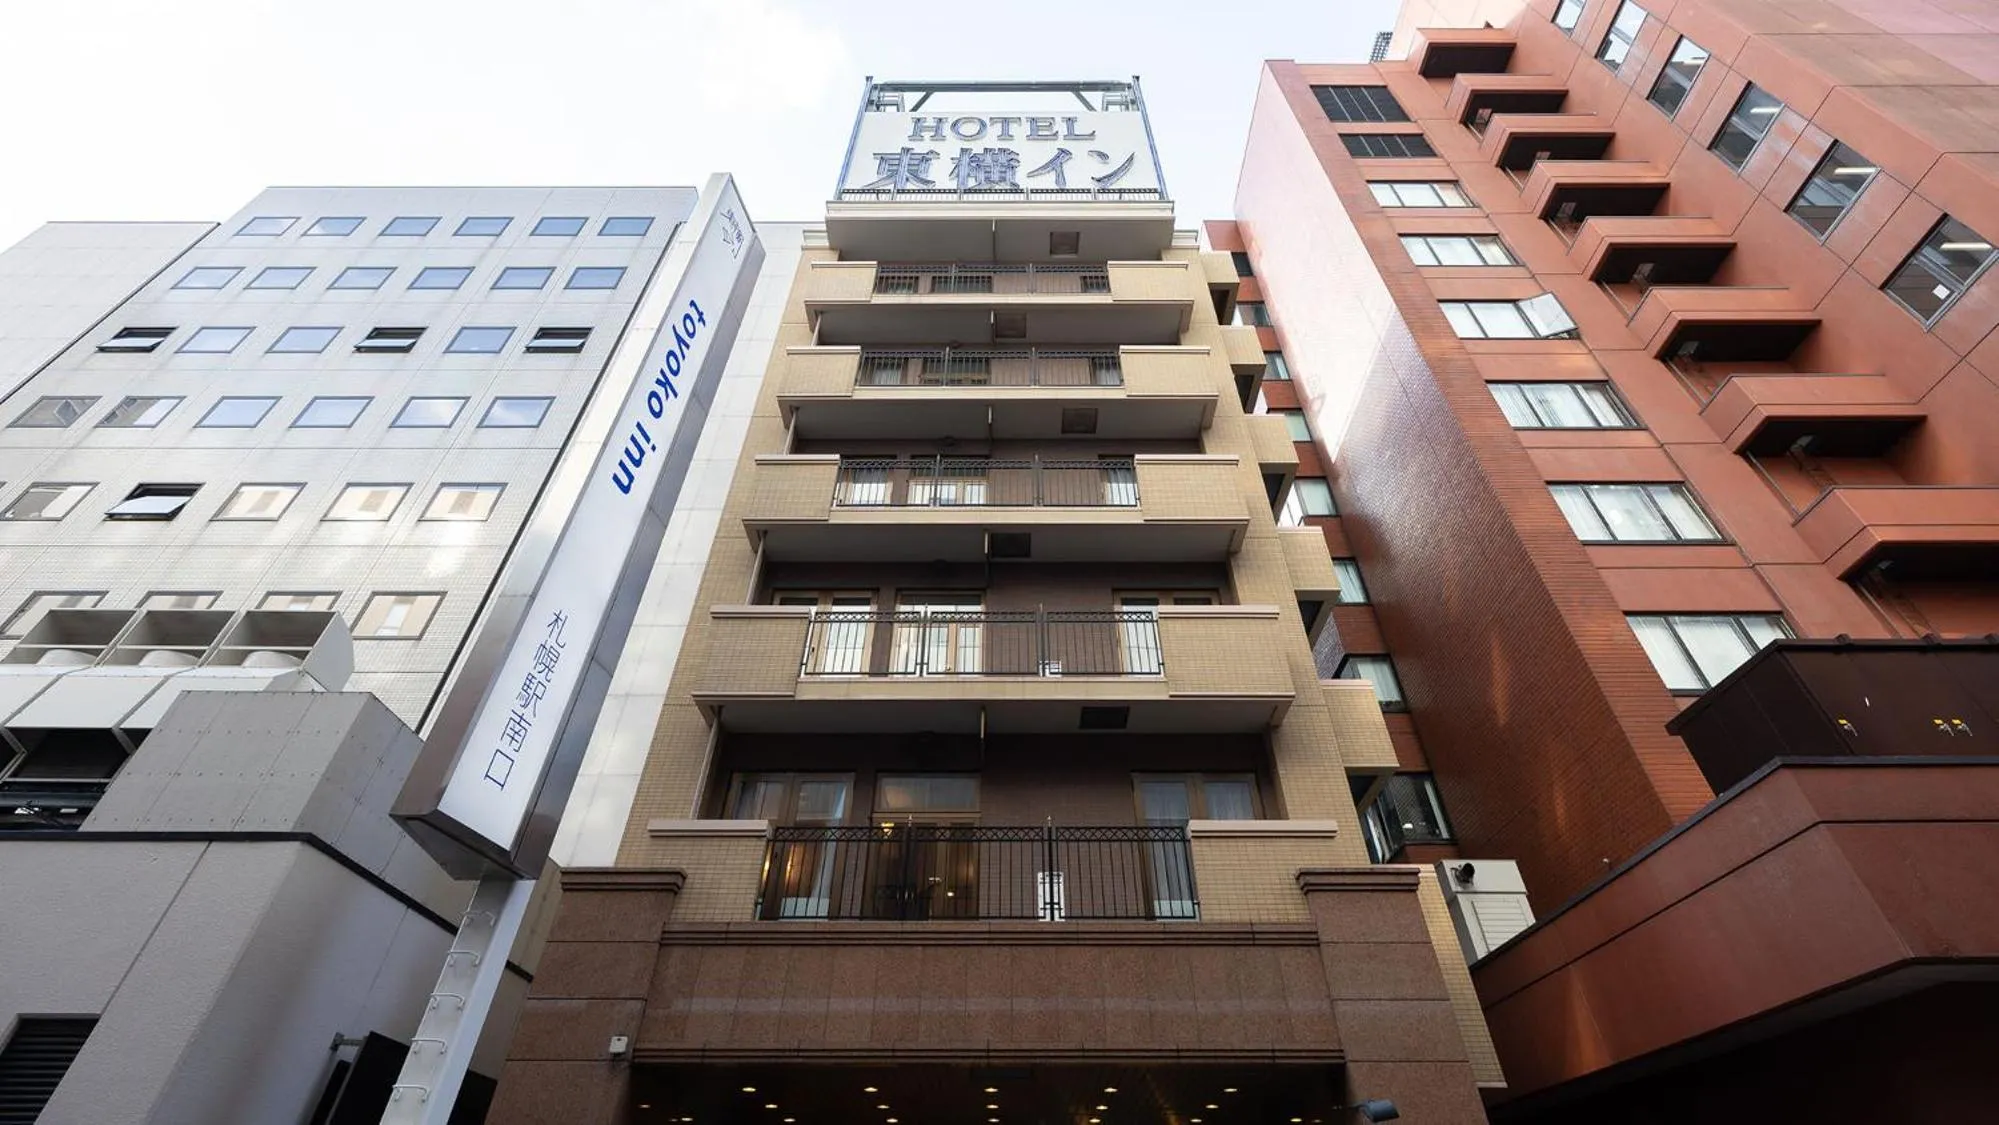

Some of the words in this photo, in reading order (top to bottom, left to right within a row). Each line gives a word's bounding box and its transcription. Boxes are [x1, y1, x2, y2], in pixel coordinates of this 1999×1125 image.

[907, 116, 1097, 142] HOTEL
[863, 147, 1136, 189] 東横イン
[647, 300, 706, 419] toyoko
[612, 421, 657, 495] inn
[484, 610, 568, 791] 札幌駅南口
